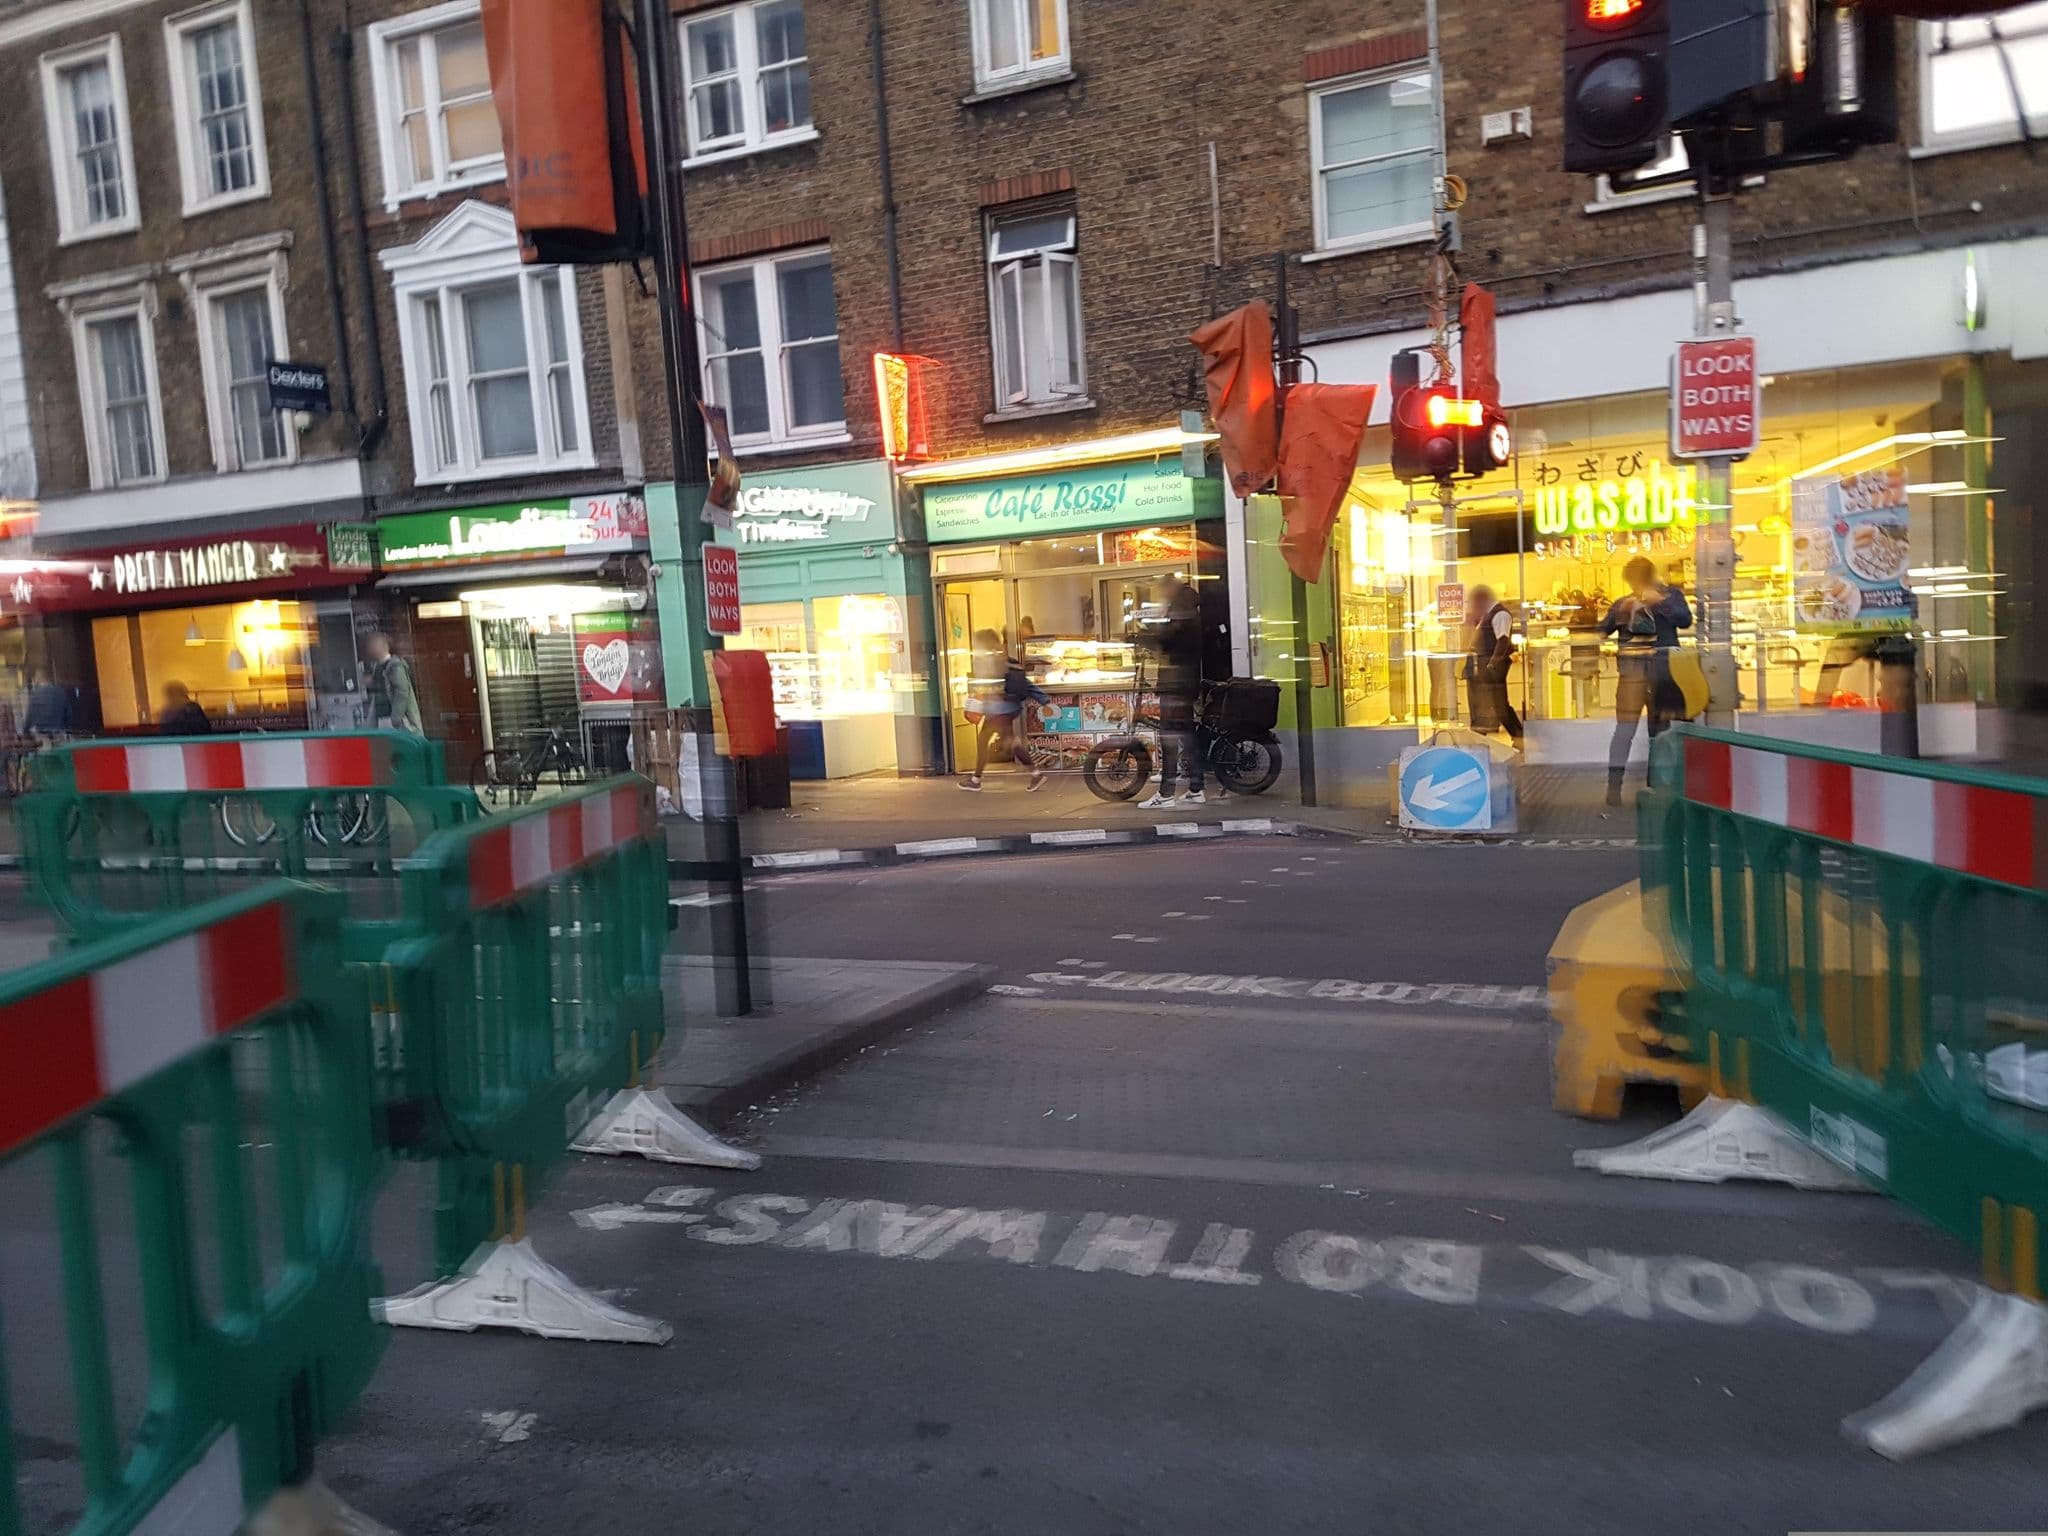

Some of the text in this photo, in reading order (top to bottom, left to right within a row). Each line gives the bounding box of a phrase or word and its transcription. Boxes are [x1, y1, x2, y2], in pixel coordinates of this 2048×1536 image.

[1683, 354, 1752, 377] LOOK
[1682, 384, 1751, 407] BOTH
[1682, 414, 1752, 436] WAYS
[1154, 467, 1182, 479] Salads
[1533, 451, 1644, 487] わさび
[984, 472, 1128, 523] Café Rossi
[1135, 494, 1183, 507] Cold Drinks
[1534, 457, 1692, 536] wasabi
[588, 500, 612, 521] 24
[936, 517, 980, 528] Sandwiches
[114, 540, 258, 594] PRET A MANGER
[707, 558, 736, 576] LOOK
[708, 580, 737, 598] BOTH
[710, 604, 739, 621] WAYS
[685, 1193, 1043, 1263] WAYS
[1052, 1209, 1484, 1304] BOTH
